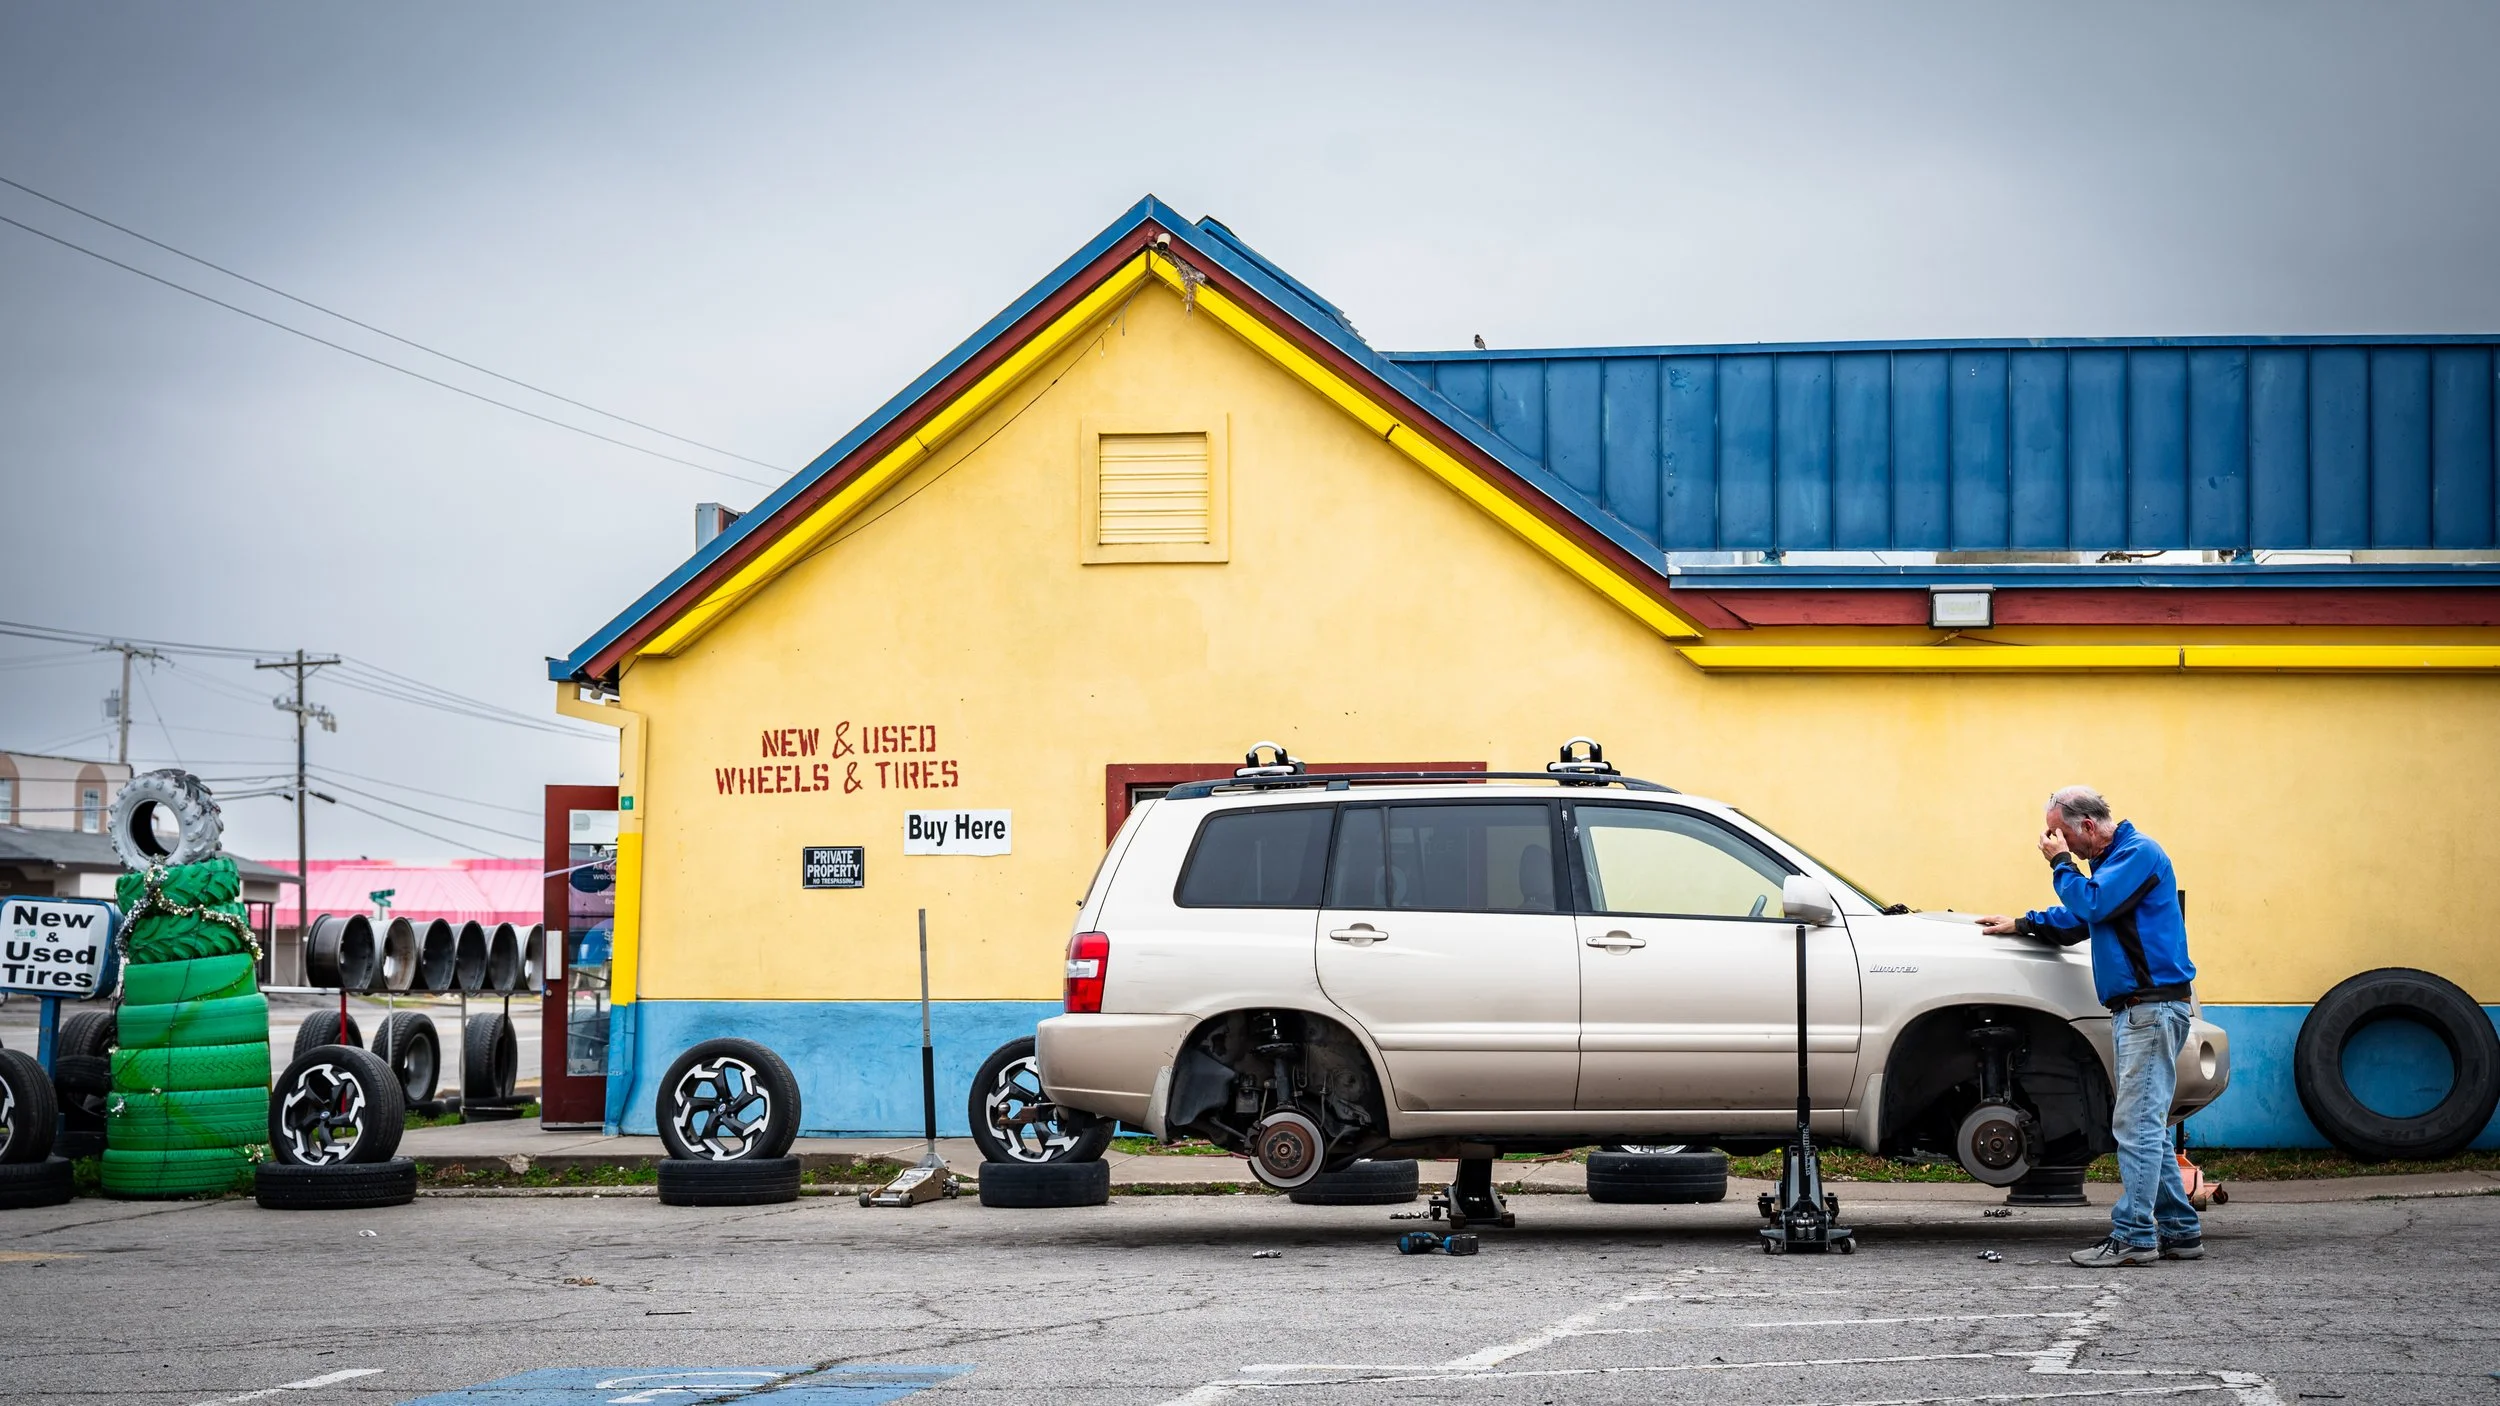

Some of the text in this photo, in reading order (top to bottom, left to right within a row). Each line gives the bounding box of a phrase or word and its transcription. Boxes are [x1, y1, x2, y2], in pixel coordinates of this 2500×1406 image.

[762, 721, 936, 759] NEW & USED
[715, 760, 959, 795] WHEELS & TIRES
[909, 814, 1006, 847] Buy Here
[813, 850, 854, 864] PRIVATE
[807, 864, 860, 878] PROPERTY
[13, 905, 95, 929] New
[46, 932, 60, 943] &
[6, 941, 97, 966] Used
[2, 963, 93, 988] Tires
[1869, 963, 1919, 974] LIMITED
[1802, 1126, 1811, 1176] PITTSBURG
